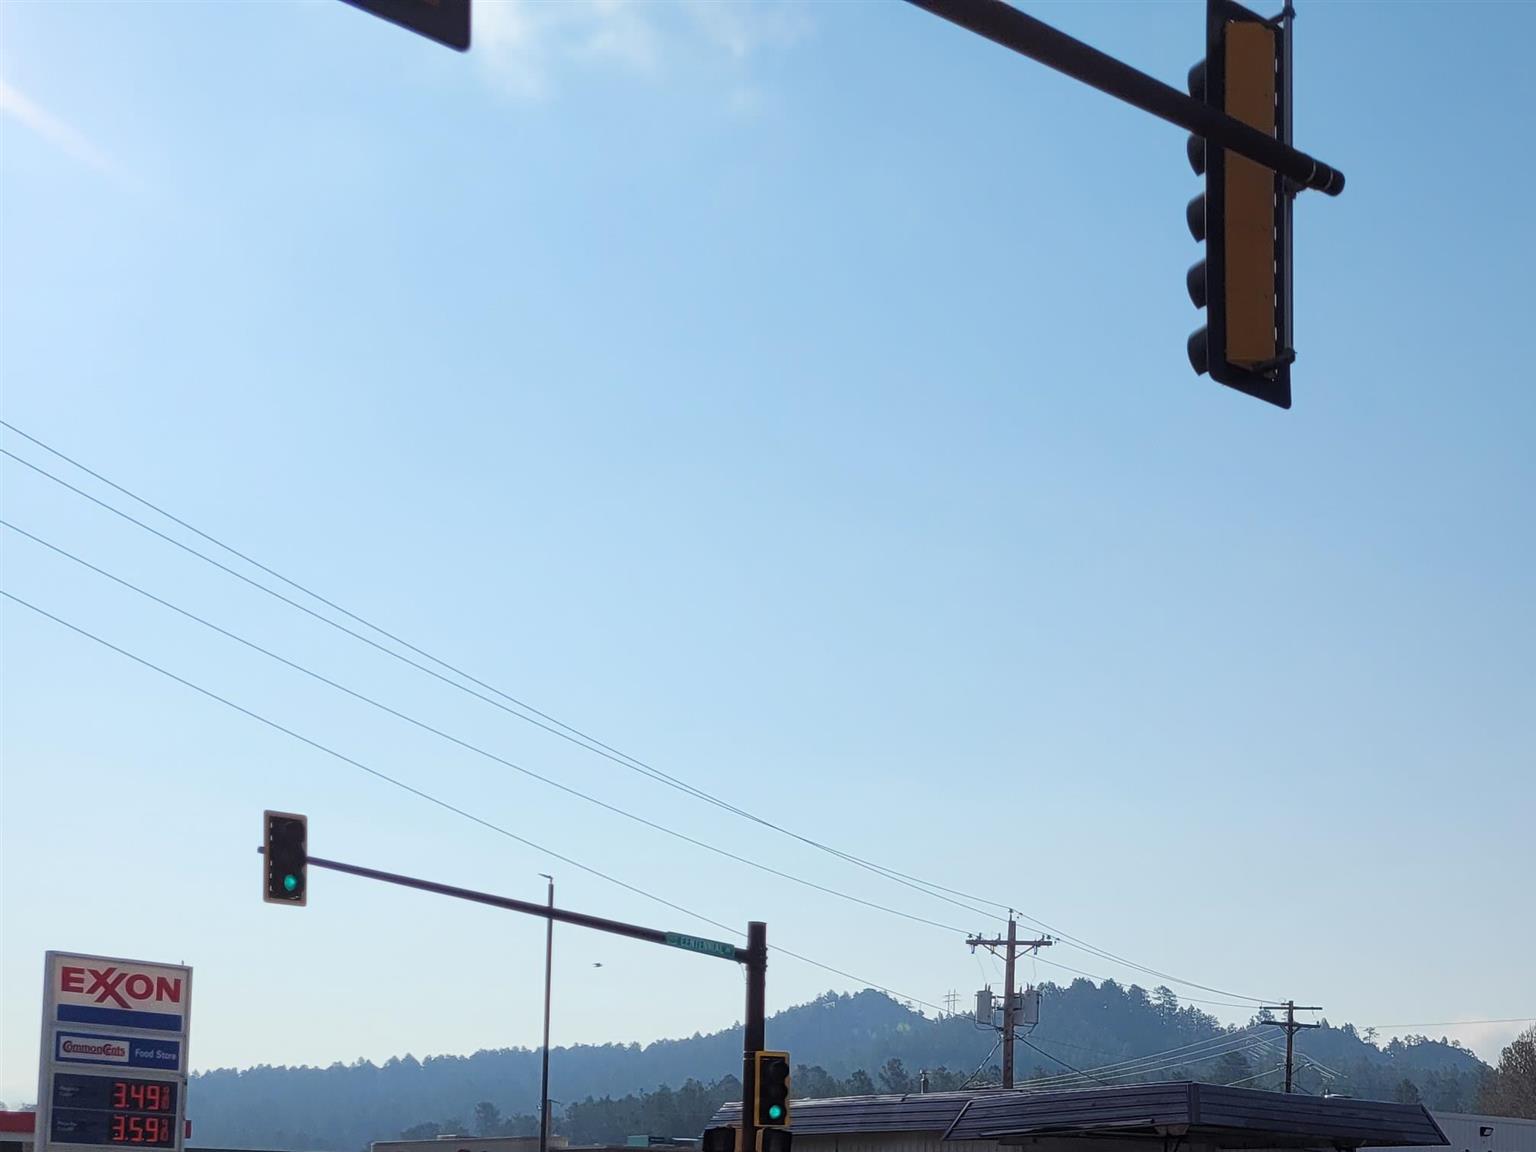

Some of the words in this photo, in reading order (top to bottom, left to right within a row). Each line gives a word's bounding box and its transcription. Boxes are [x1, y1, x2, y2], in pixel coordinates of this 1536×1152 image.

[61, 966, 182, 1009] EXXON
[135, 1048, 155, 1059] Food
[156, 1050, 177, 1061] Store
